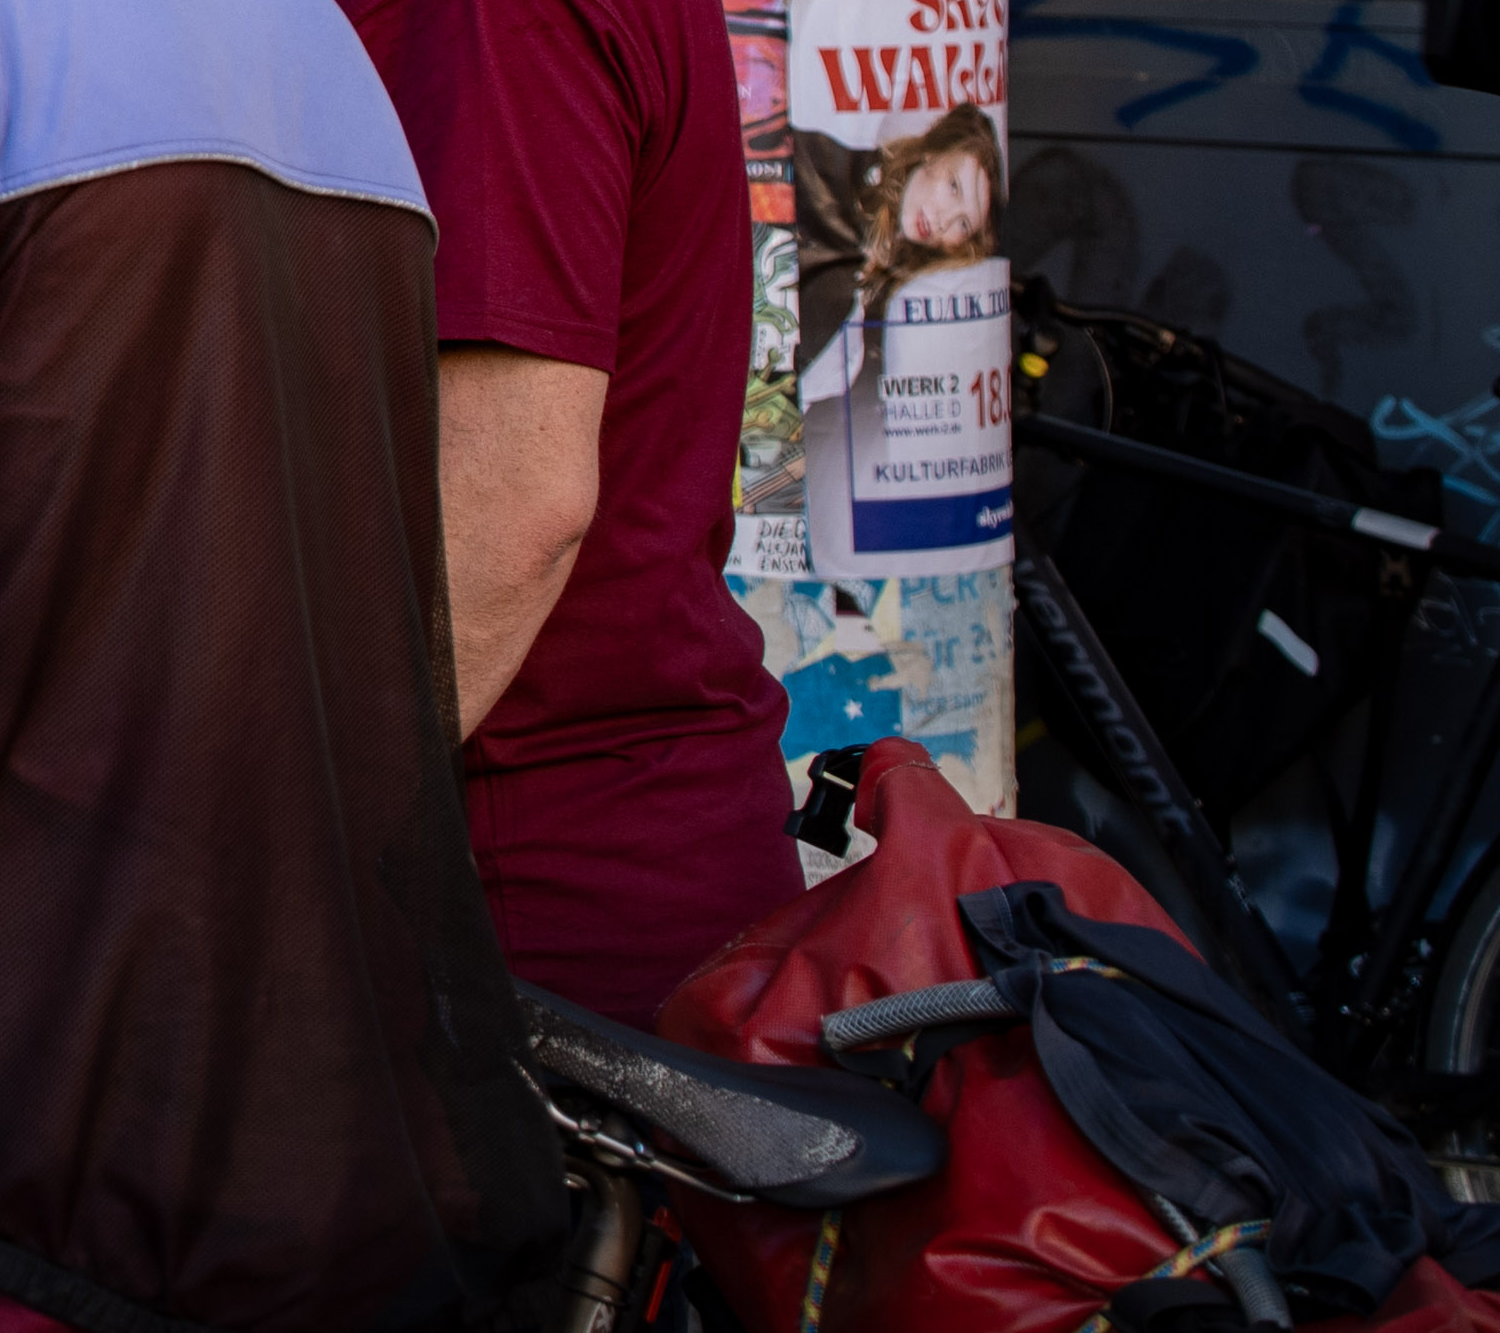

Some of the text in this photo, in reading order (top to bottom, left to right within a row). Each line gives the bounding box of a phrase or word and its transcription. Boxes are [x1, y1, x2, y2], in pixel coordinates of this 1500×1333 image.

[883, 376, 945, 398] WERK
[949, 374, 960, 394] 2
[883, 401, 944, 421] HALLE
[874, 453, 1005, 483] KULTURFABRIK
